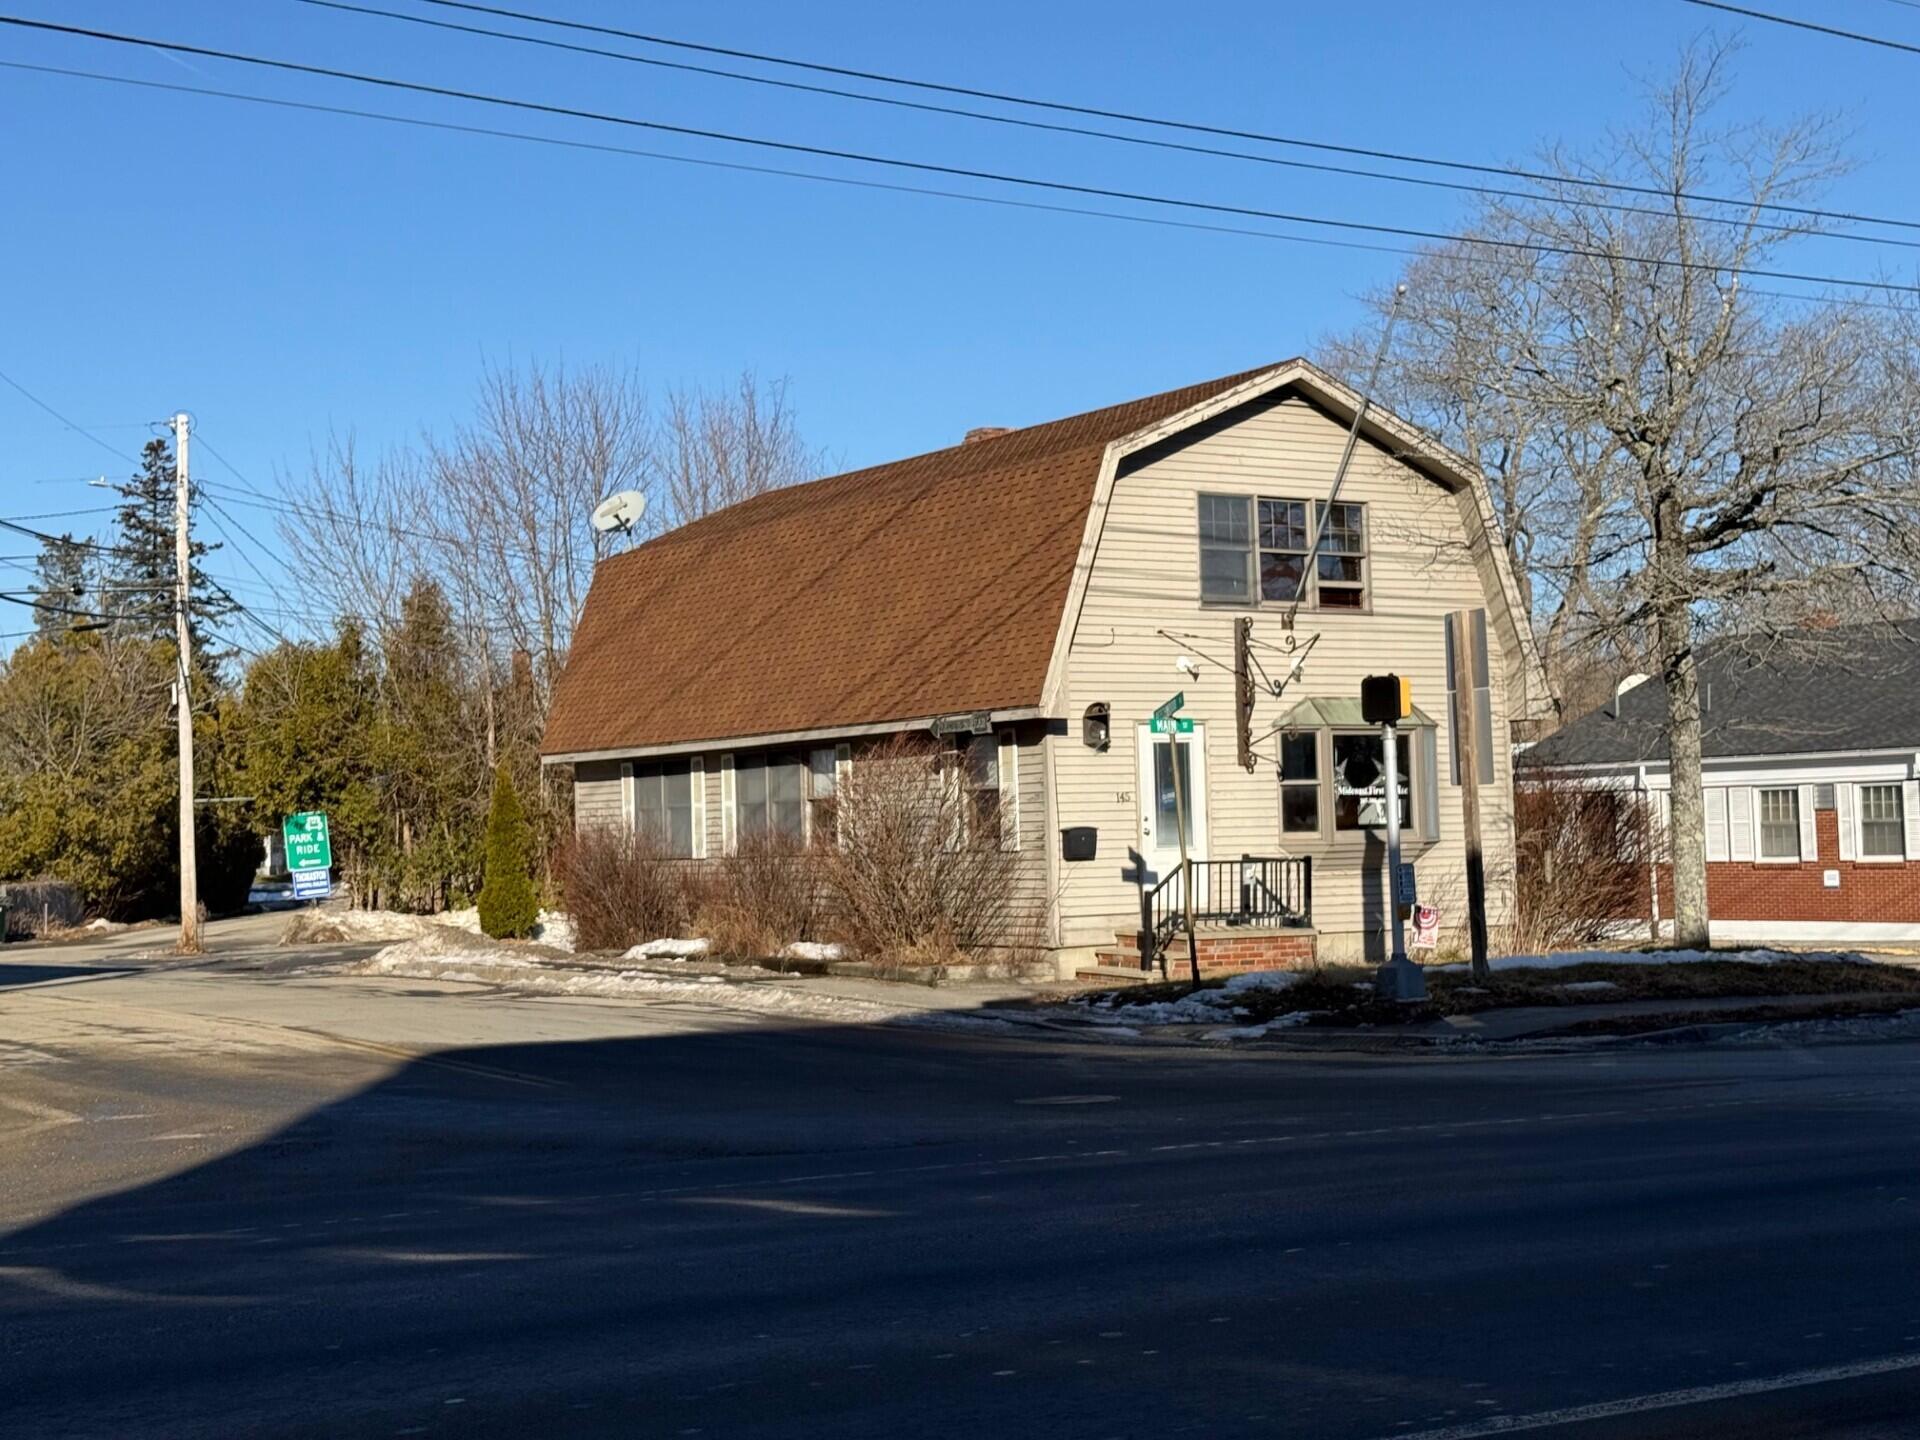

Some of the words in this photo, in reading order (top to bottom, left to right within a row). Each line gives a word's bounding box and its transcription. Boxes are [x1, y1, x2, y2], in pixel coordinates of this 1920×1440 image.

[1156, 719, 1177, 732] MAIN
[1116, 791, 1131, 803] 145
[289, 832, 313, 844] PARK
[317, 831, 324, 842] &
[296, 844, 320, 856] RIDE
